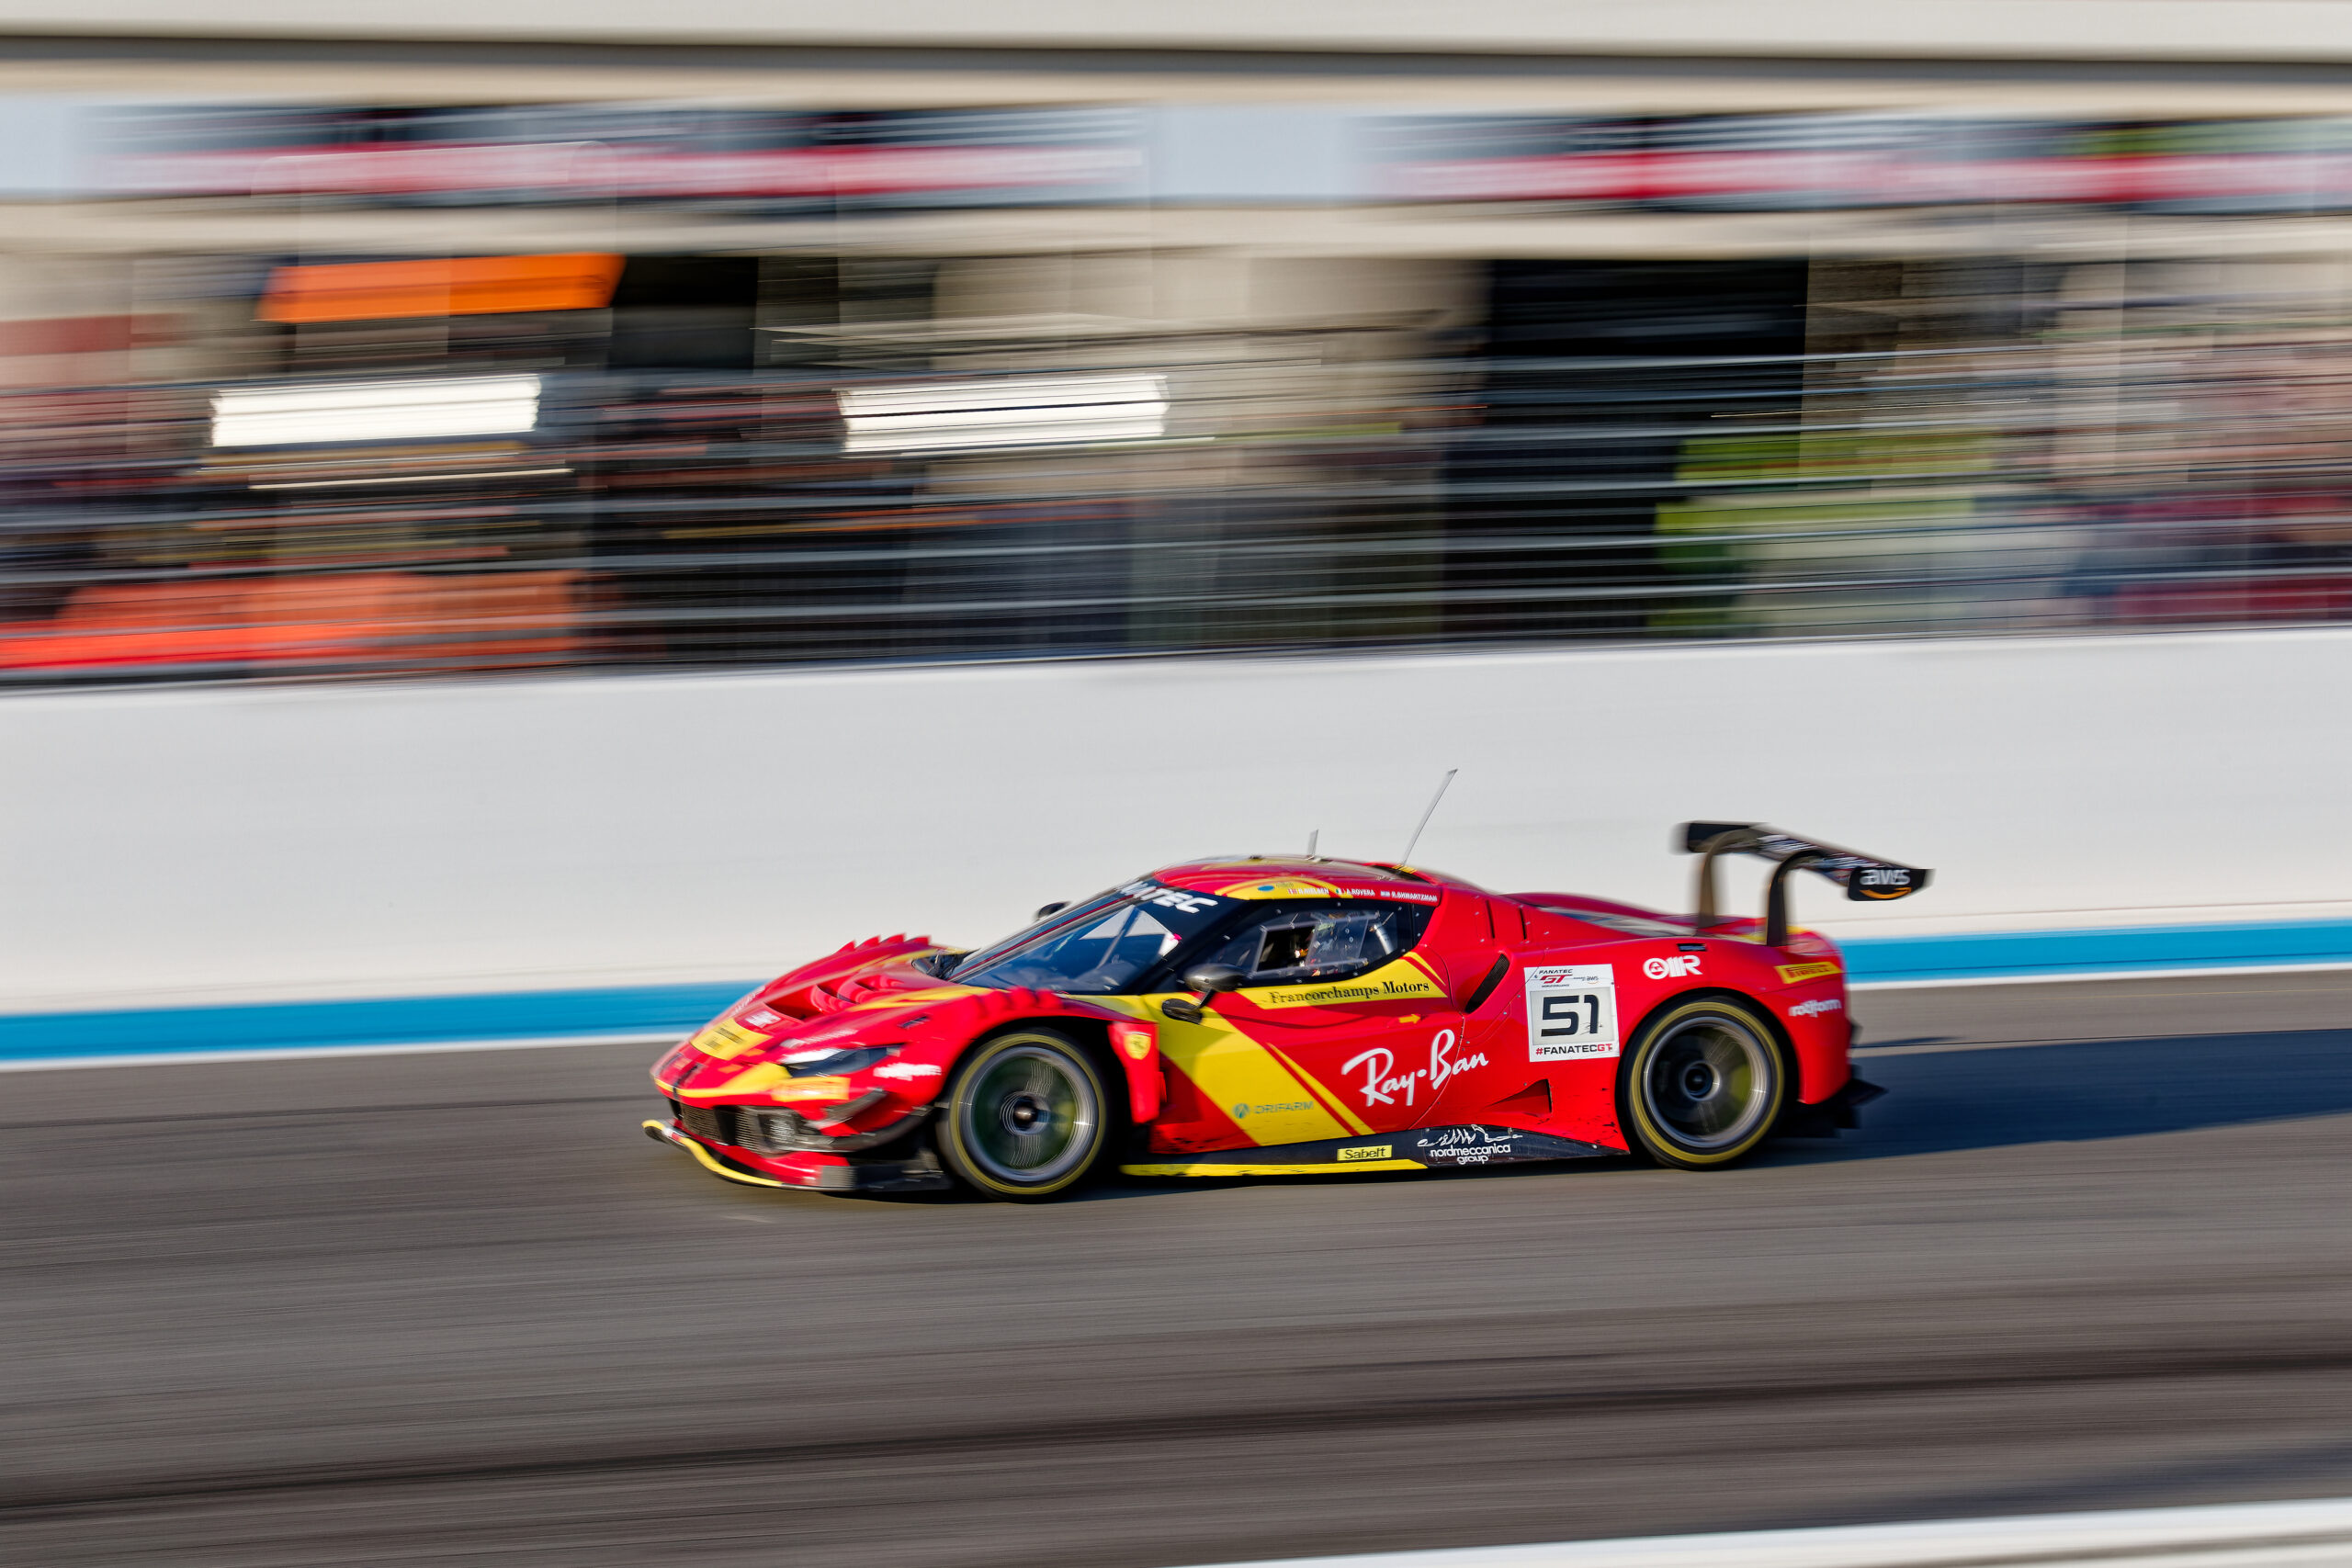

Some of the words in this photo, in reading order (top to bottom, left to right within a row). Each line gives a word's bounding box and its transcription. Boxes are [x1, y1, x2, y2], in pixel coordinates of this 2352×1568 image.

[1859, 869, 1911, 886] aws
[1540, 974, 1573, 984] GT
[1269, 986, 1380, 1004] Francorchamps
[1382, 980, 1430, 994] Motors
[1541, 994, 1600, 1037] 51
[1535, 1043, 1613, 1055] #FANATECGT
[1345, 1147, 1385, 1159] Sabelt
[1430, 1143, 1511, 1157] nordmeccanica
[1456, 1155, 1489, 1165] group
